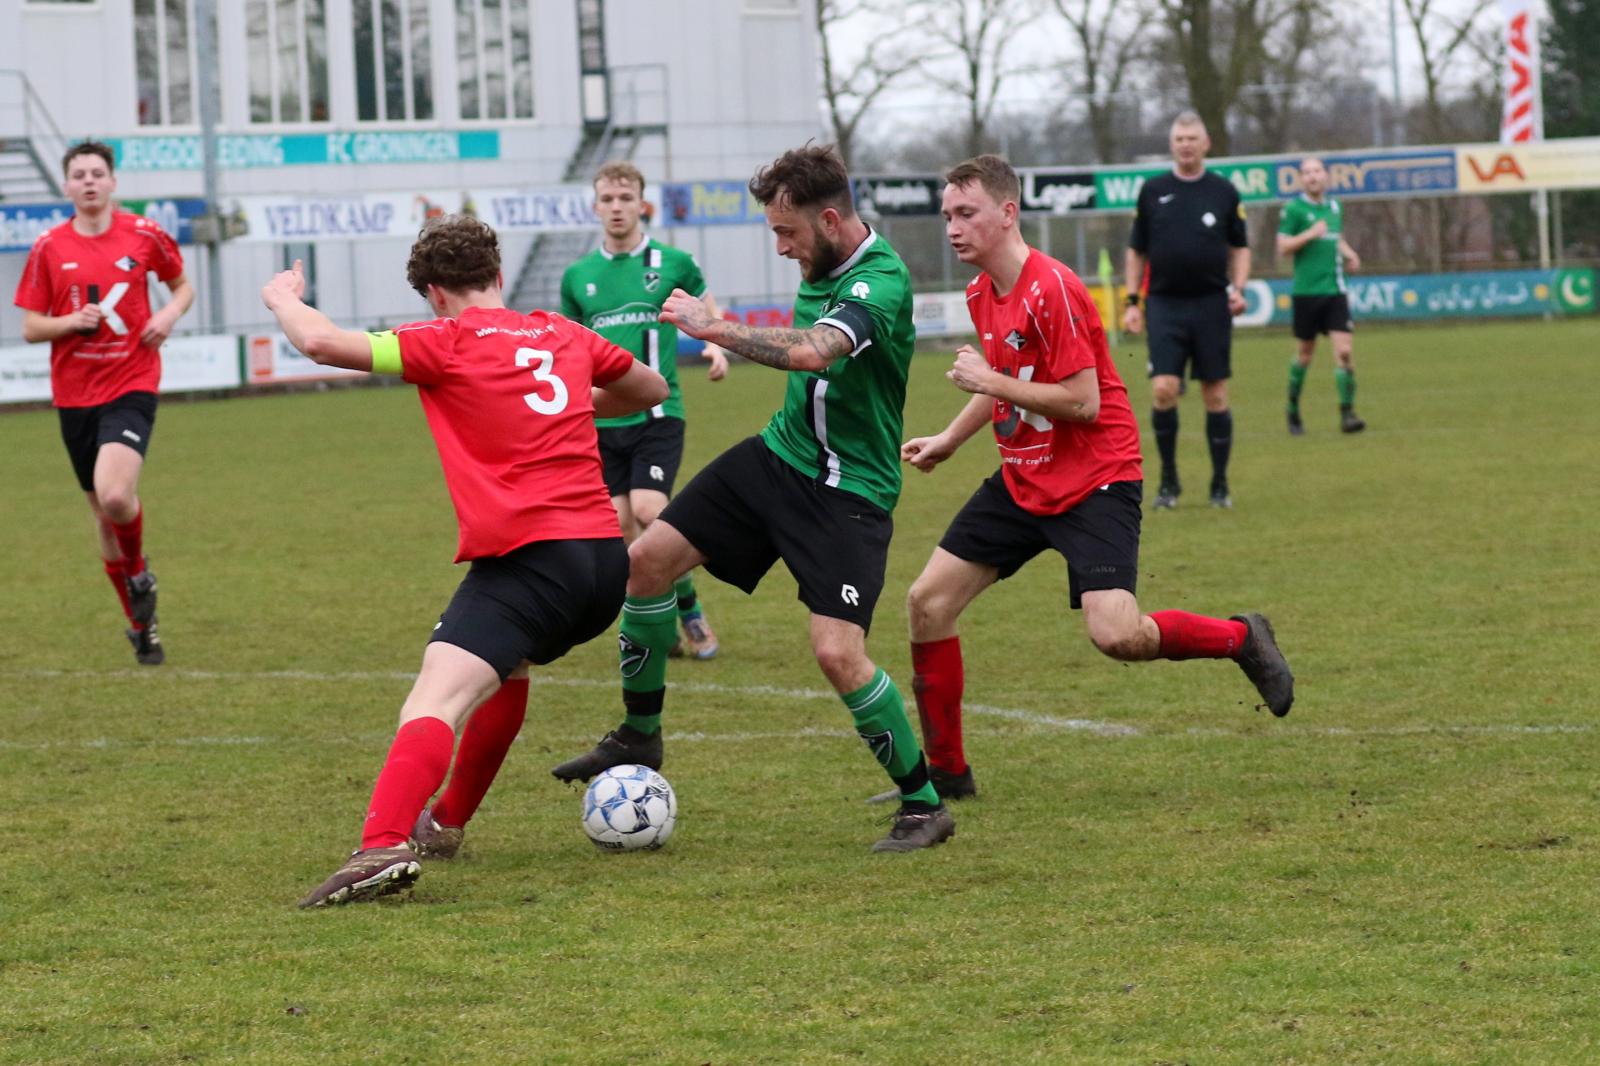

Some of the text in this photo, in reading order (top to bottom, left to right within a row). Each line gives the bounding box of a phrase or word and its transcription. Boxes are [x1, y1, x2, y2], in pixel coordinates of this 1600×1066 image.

[264, 203, 395, 235] VELDKAMP
[491, 196, 602, 226] VELDKAM
[515, 347, 569, 416] 3
